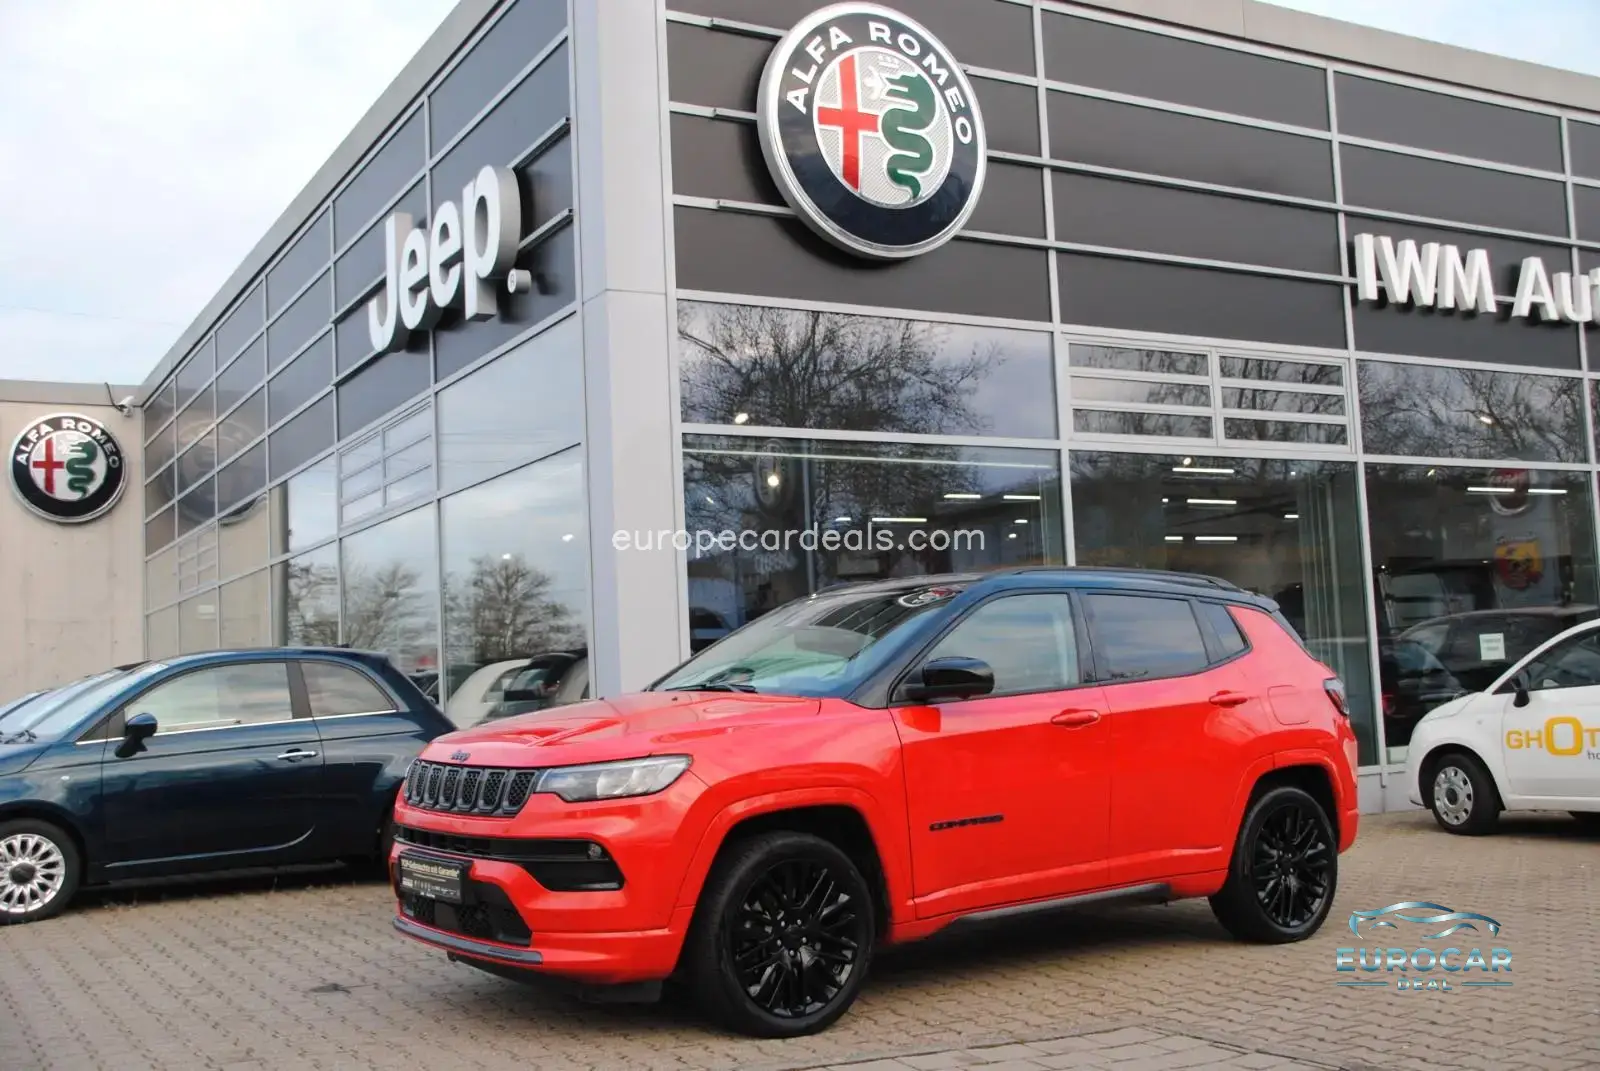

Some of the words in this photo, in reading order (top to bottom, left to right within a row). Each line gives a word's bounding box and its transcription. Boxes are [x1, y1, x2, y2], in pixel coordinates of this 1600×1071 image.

[786, 26, 853, 115] ALFA
[868, 21, 973, 145] ROMEO
[368, 165, 521, 353] Jeep
[1354, 232, 1497, 313] IWM
[15, 423, 54, 466] ALFA
[61, 418, 120, 469] ROMEO
